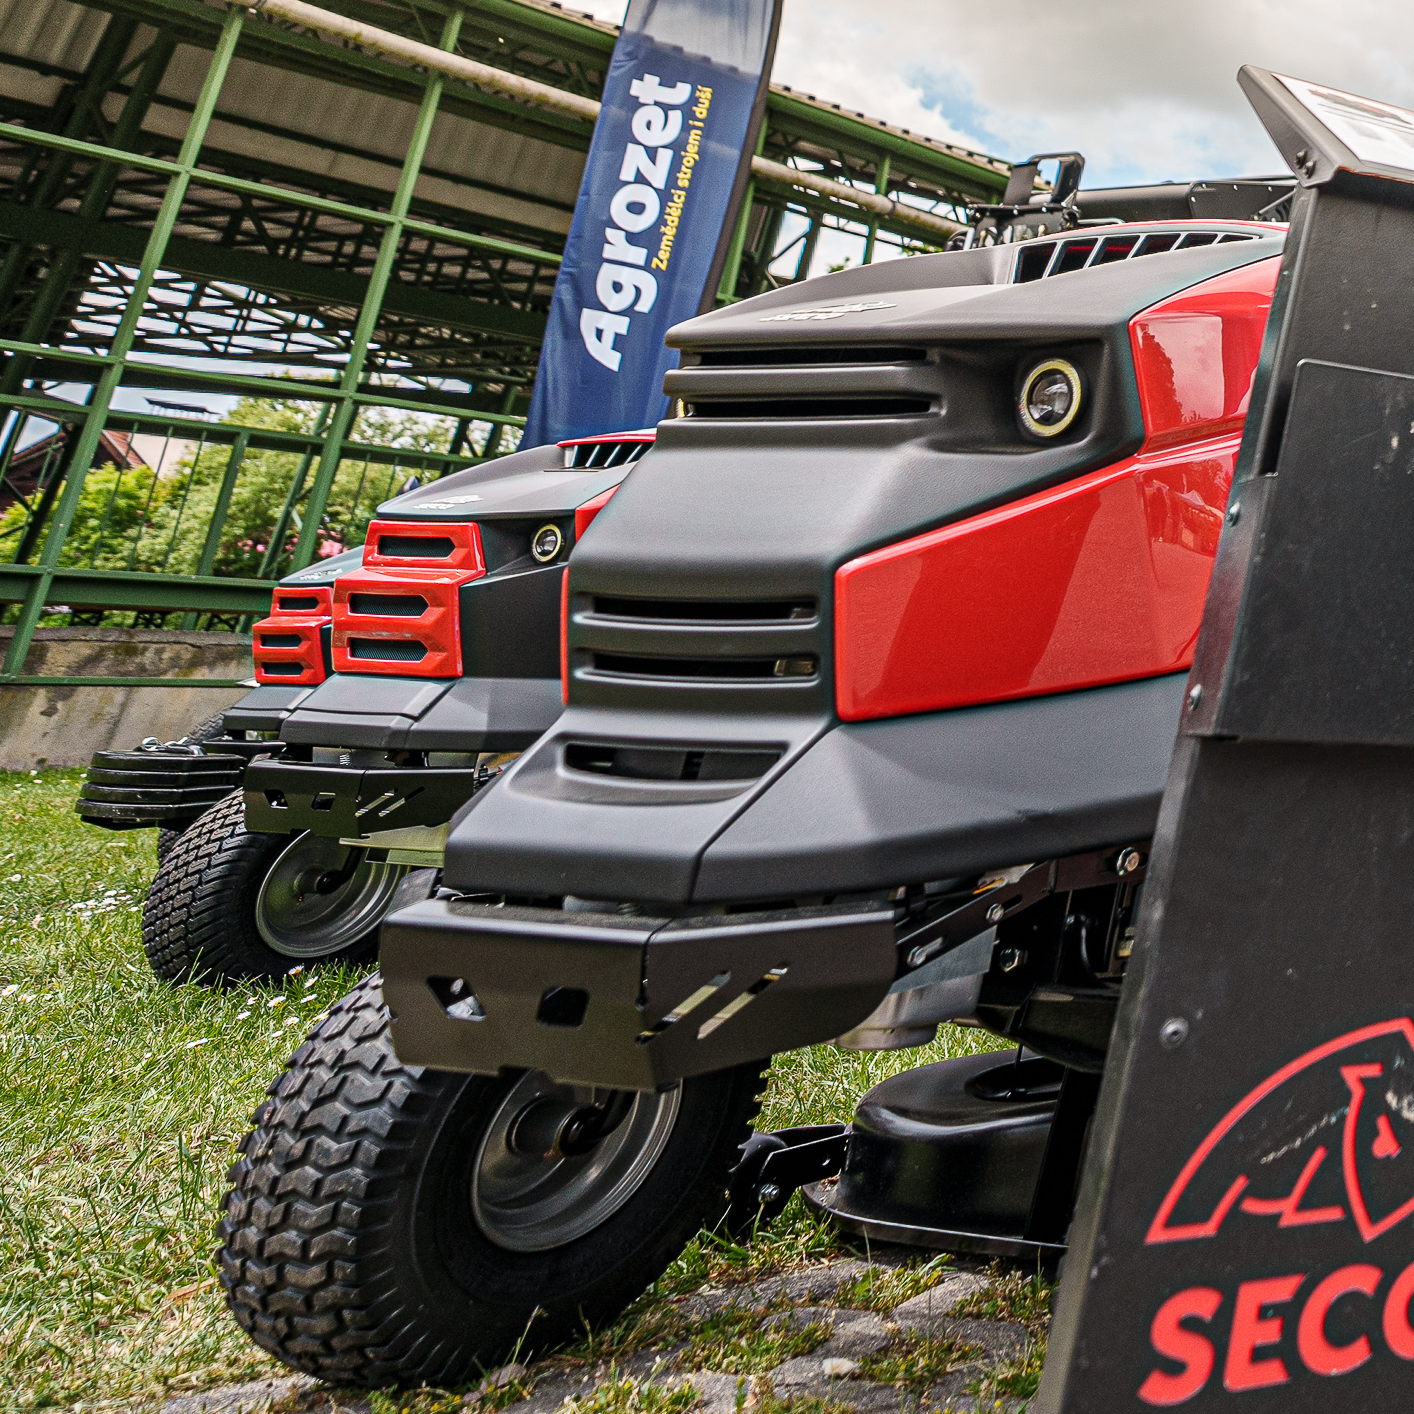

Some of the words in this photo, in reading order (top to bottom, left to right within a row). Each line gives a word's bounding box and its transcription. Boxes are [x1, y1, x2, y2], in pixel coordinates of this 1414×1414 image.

[688, 119, 705, 128] i
[691, 84, 713, 120] duší
[676, 129, 703, 189] strojem
[579, 72, 693, 373] Agrozet
[651, 188, 687, 272] Zemědělci
